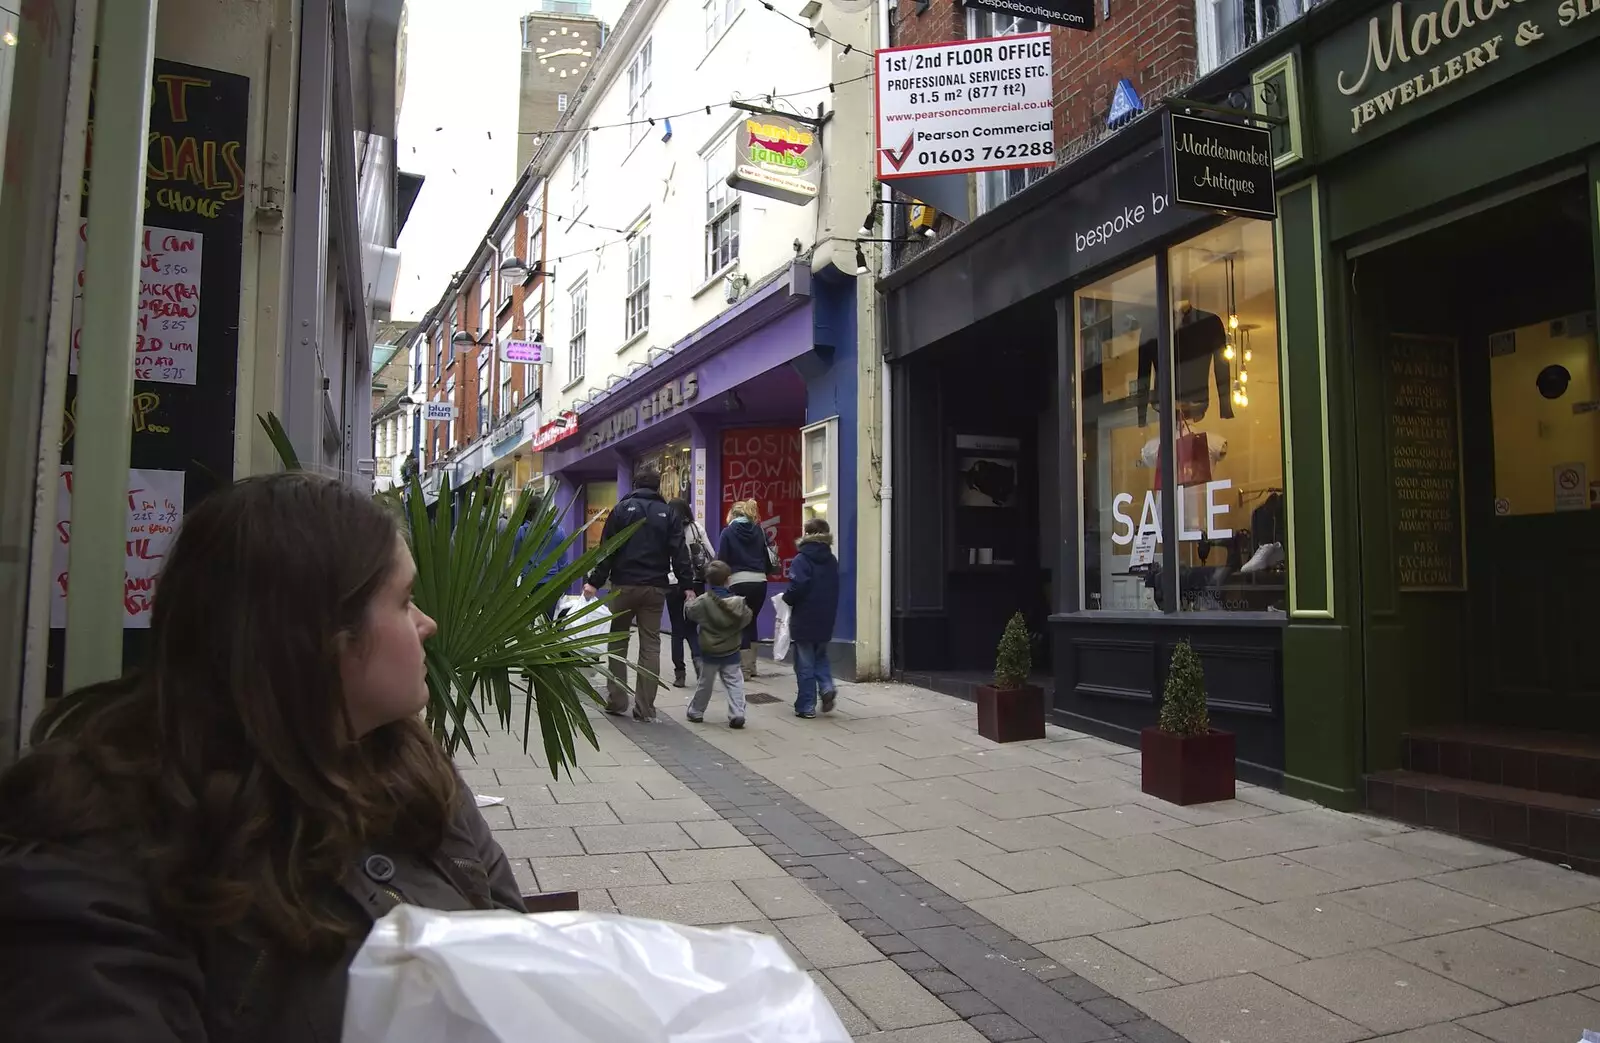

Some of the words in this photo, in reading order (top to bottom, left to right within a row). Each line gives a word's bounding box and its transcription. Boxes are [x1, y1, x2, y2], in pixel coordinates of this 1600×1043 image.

[886, 53, 941, 72] 1st/2nd
[947, 47, 993, 67] FLOOR
[998, 41, 1051, 61] OFFICE
[888, 73, 966, 91] PROFESSIONAL
[970, 67, 1021, 84] SERVICES
[1025, 65, 1049, 79] ETC.
[1350, 35, 1503, 134] JEWELLERY
[1515, 20, 1544, 47] &
[910, 91, 939, 104] 81.5
[968, 85, 998, 102] (877
[886, 99, 1053, 122] www.pearsoncommercial.co.uk
[917, 130, 969, 142] Pearson
[973, 121, 1053, 138] Commercial
[751, 145, 807, 169] jambo
[919, 148, 975, 165] 01603
[982, 141, 1053, 161] 762288
[1176, 133, 1270, 167] Maddermarket
[146, 132, 244, 200] CIALS
[1194, 166, 1255, 197] Antiques
[1075, 205, 1145, 252] bespoke
[428, 404, 451, 412] blue
[1394, 395, 1448, 409] JEWELLERY
[723, 434, 800, 456] CLOSIN
[1394, 446, 1416, 457] GOOD
[1419, 447, 1453, 459] QUALITY
[723, 480, 803, 503] EVERYTHIN
[1395, 476, 1418, 488] GOOD
[1421, 478, 1454, 490] QUALITY
[1398, 489, 1450, 501] SILVERWARE
[1111, 479, 1233, 545] SALE
[1398, 508, 1418, 518] TOP
[1420, 508, 1451, 520] PRICES
[1399, 521, 1431, 532] ALWAYS
[1434, 521, 1453, 532] PAID
[1413, 540, 1439, 553] PART
[1399, 554, 1451, 569] EXCHANGE
[1400, 570, 1451, 584] WELCOME
